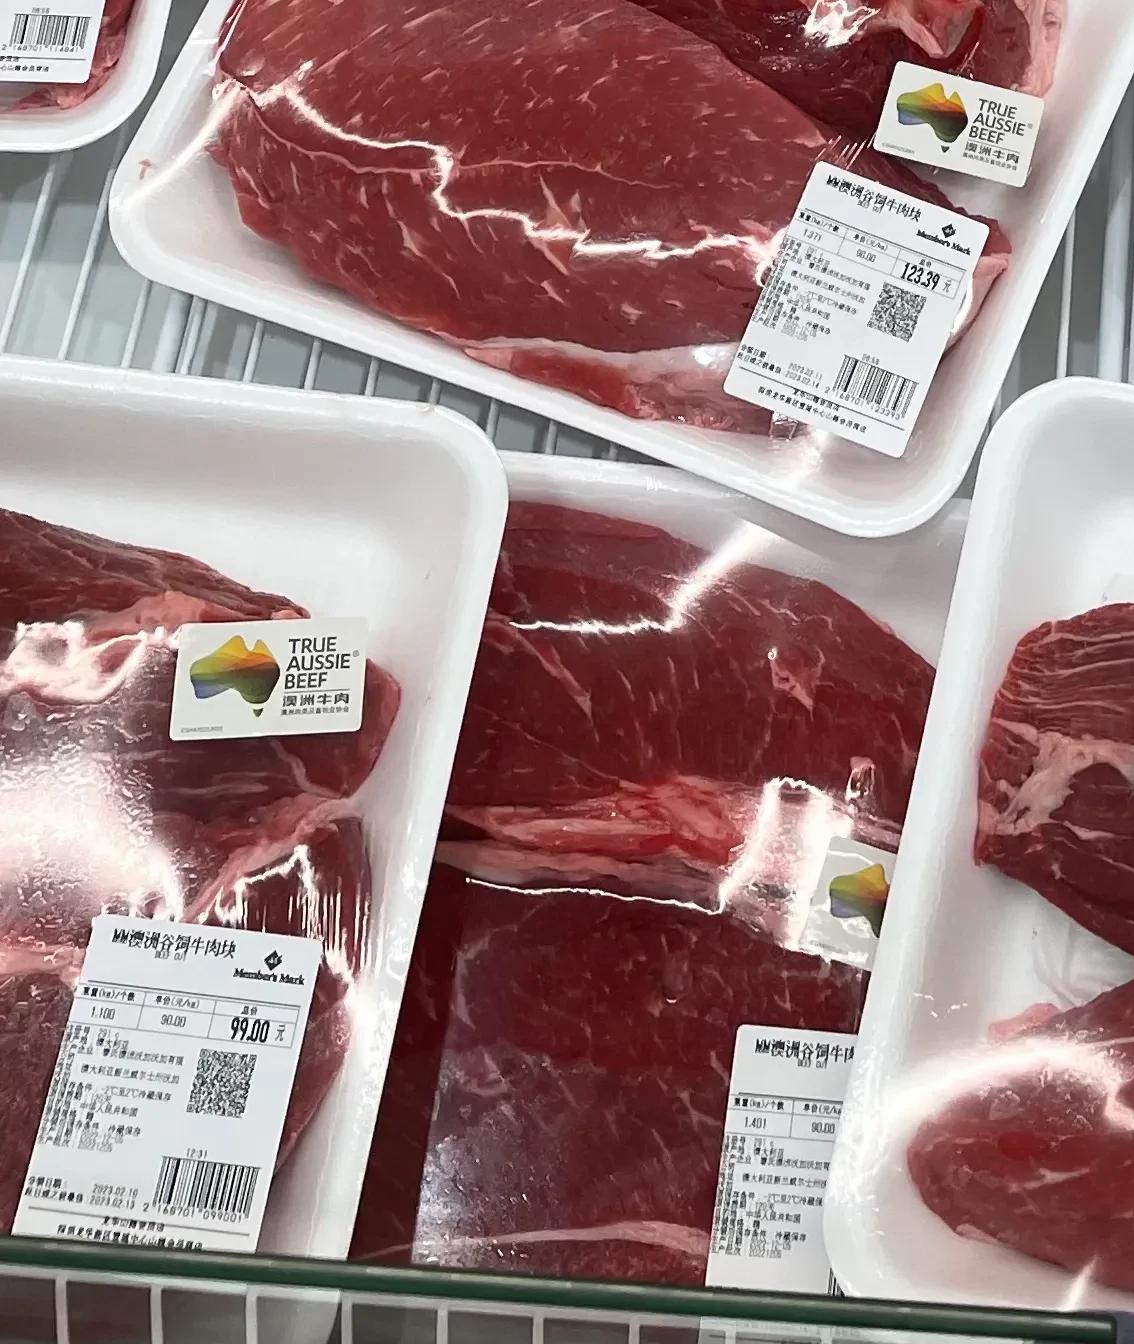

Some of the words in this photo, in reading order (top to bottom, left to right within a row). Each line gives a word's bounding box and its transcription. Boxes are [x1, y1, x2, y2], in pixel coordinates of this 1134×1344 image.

[978, 98, 1018, 120] TRUE
[973, 112, 1026, 137] AUSSIE
[968, 126, 1006, 145] BEEF
[900, 262, 941, 291] 123.39
[288, 636, 338, 654] TRUE
[286, 653, 351, 672] AUSSIE
[284, 672, 328, 690] BEEF
[282, 693, 350, 707] 澳洲牛肉
[231, 1016, 271, 1043] 99.00
